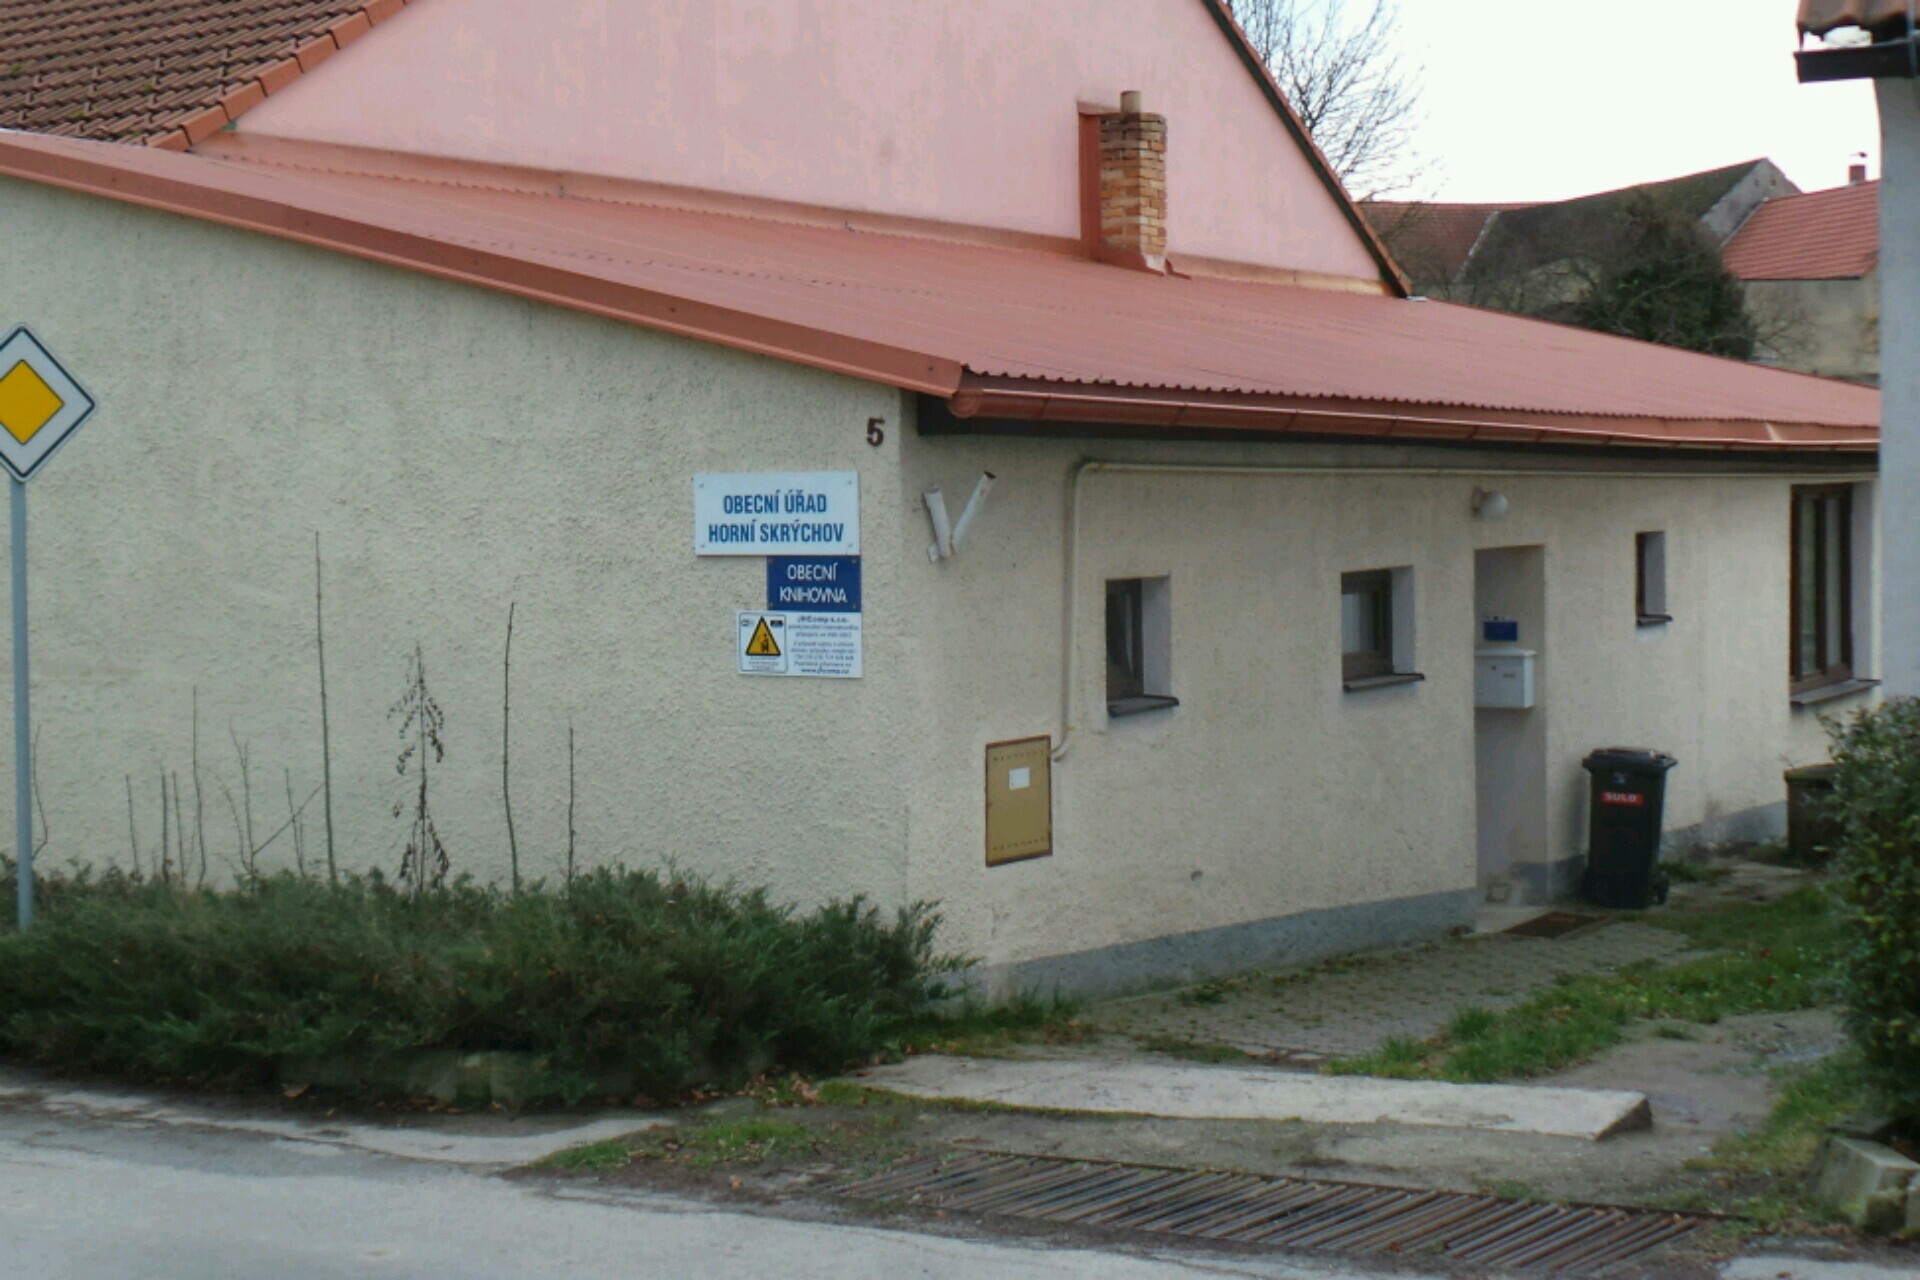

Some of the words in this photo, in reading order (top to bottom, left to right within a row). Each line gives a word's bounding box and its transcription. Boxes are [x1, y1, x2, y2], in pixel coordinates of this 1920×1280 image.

[866, 417, 886, 447] 5
[723, 489, 780, 515] OBECNÍ
[784, 488, 828, 513] ÚŘAD
[708, 519, 757, 543] HORNÍ
[759, 518, 844, 543] SKRÝCHOV
[786, 562, 839, 582] OBECNÍ
[779, 585, 848, 604] KNIHOVNA
